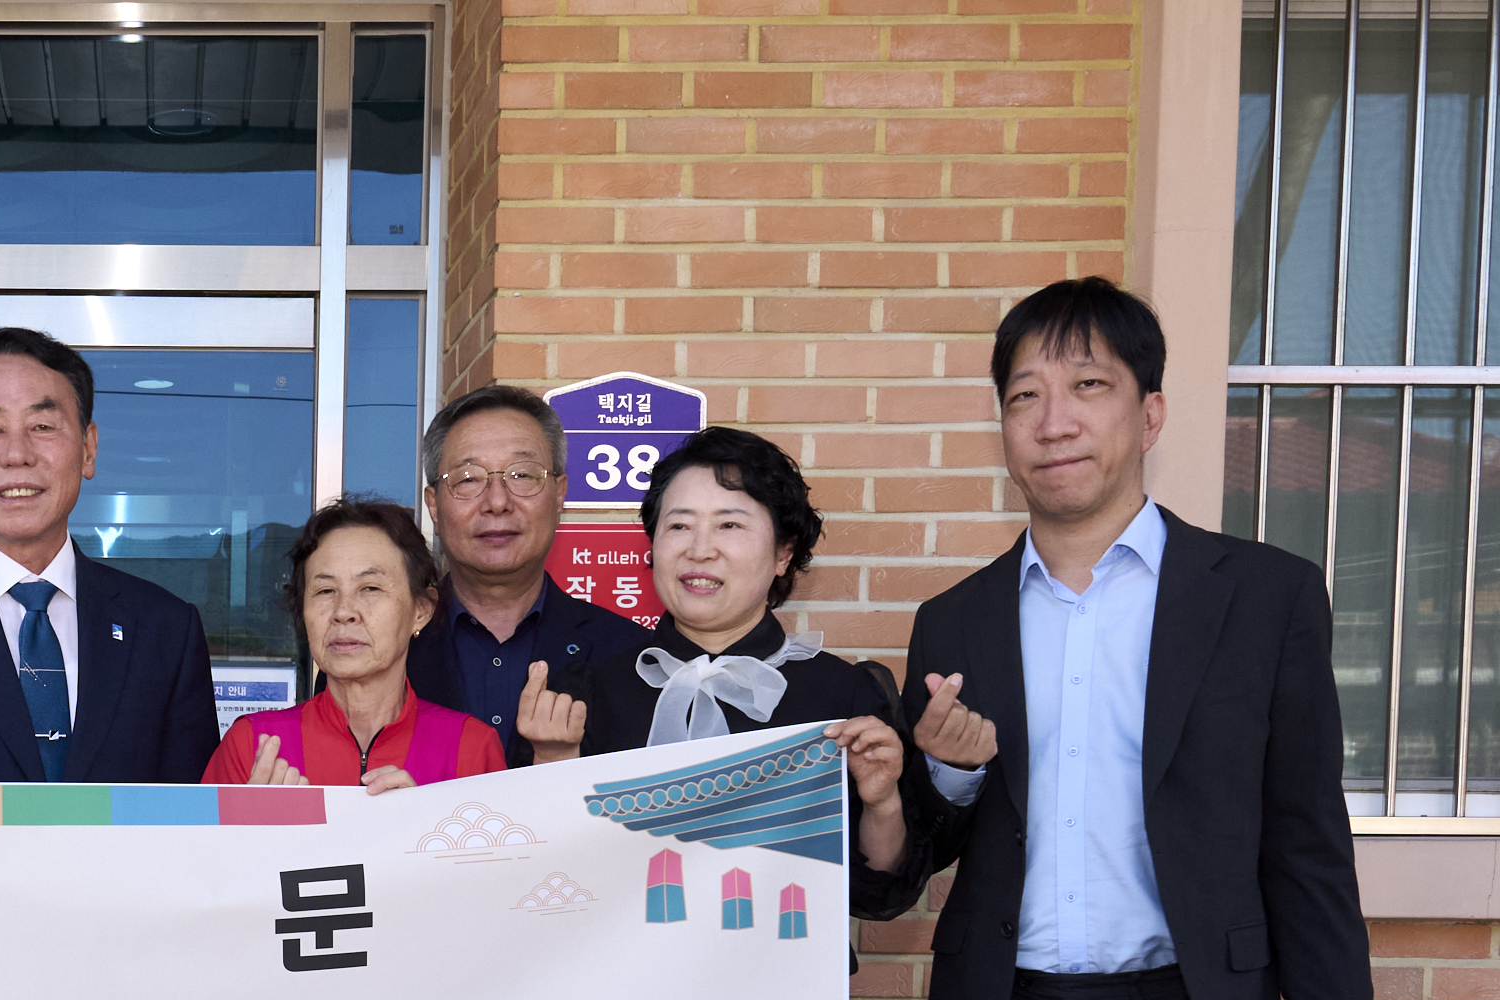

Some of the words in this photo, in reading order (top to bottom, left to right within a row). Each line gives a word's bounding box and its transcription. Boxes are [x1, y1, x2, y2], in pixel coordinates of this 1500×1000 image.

[598, 393, 652, 413] 택지길
[597, 414, 652, 426] Taekji-gil
[585, 444, 660, 491] 38
[572, 548, 592, 565] kt
[597, 551, 639, 565] olleh
[228, 686, 247, 697] 안내
[275, 863, 373, 973] 문
